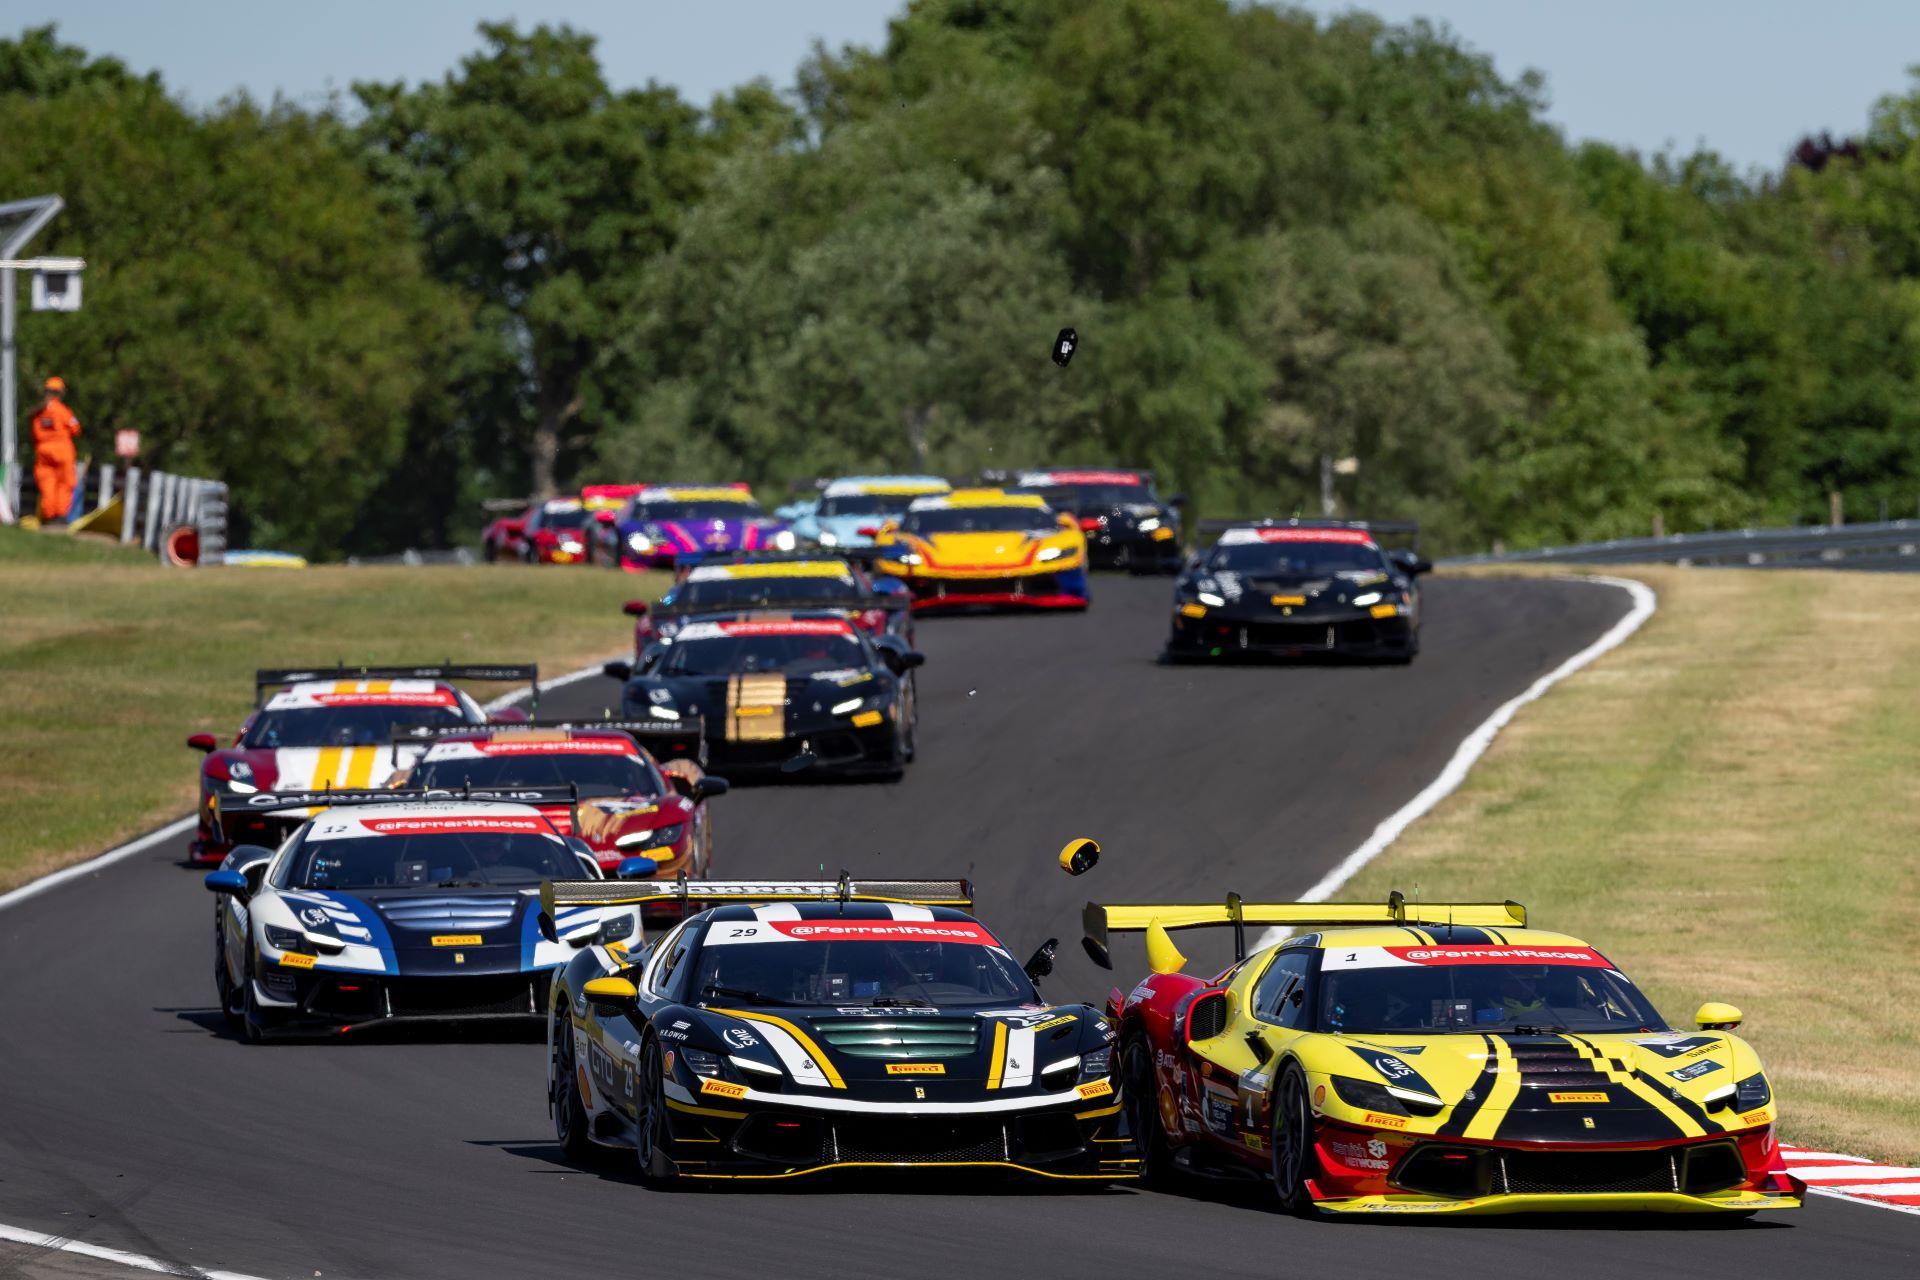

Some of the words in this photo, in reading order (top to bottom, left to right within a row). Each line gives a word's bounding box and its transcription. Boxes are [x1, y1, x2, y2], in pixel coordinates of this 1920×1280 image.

[375, 819, 536, 830] @FerrariRaces
[729, 928, 758, 938] 29
[790, 925, 978, 939] @FerrariRaces
[1345, 953, 1358, 962] 1
[1406, 949, 1593, 961] @FerrariRaces
[731, 1028, 760, 1047] aws
[1382, 1057, 1415, 1077] aws
[624, 1063, 634, 1098] 29
[705, 1081, 744, 1096] PIRELLI
[1079, 1082, 1110, 1098] PIRELLI
[1365, 1113, 1406, 1128] PIRELLI
[1743, 1111, 1769, 1125] PIRELLI
